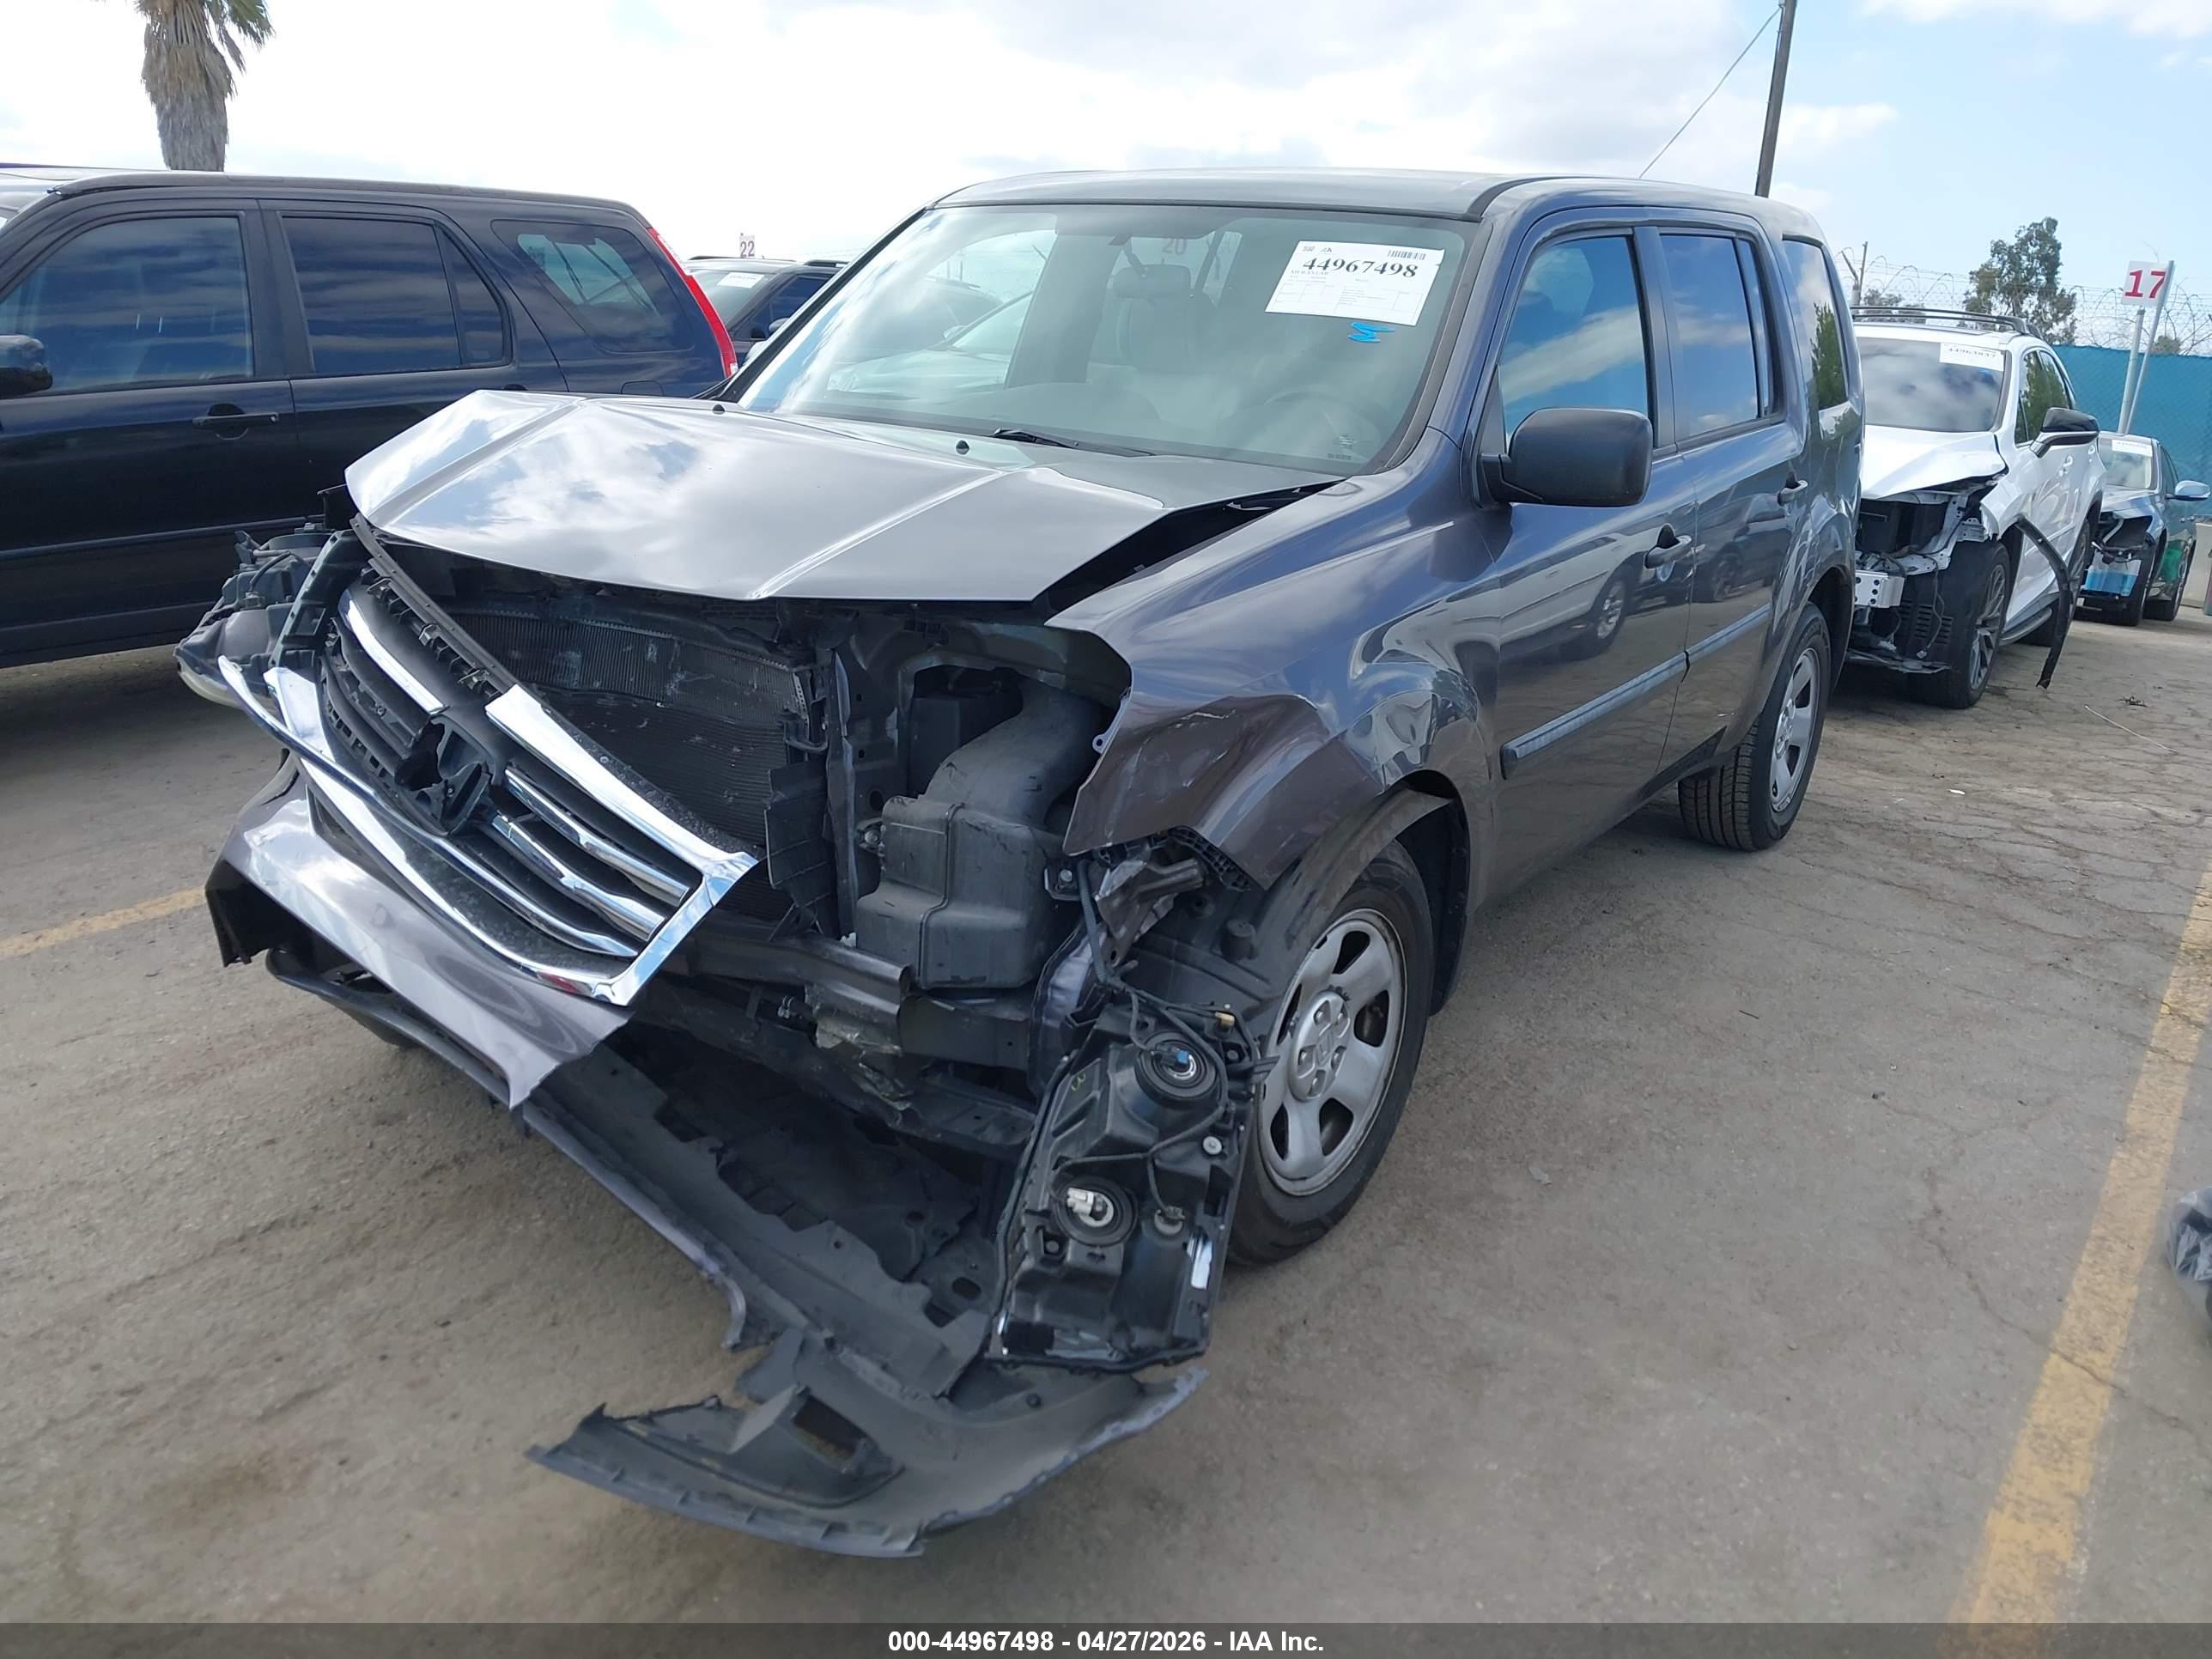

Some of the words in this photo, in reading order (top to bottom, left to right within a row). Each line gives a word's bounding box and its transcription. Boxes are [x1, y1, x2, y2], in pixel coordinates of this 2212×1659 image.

[740, 240, 755, 258] 22
[1303, 258, 1418, 277] 44967498
[2124, 270, 2166, 299] 17
